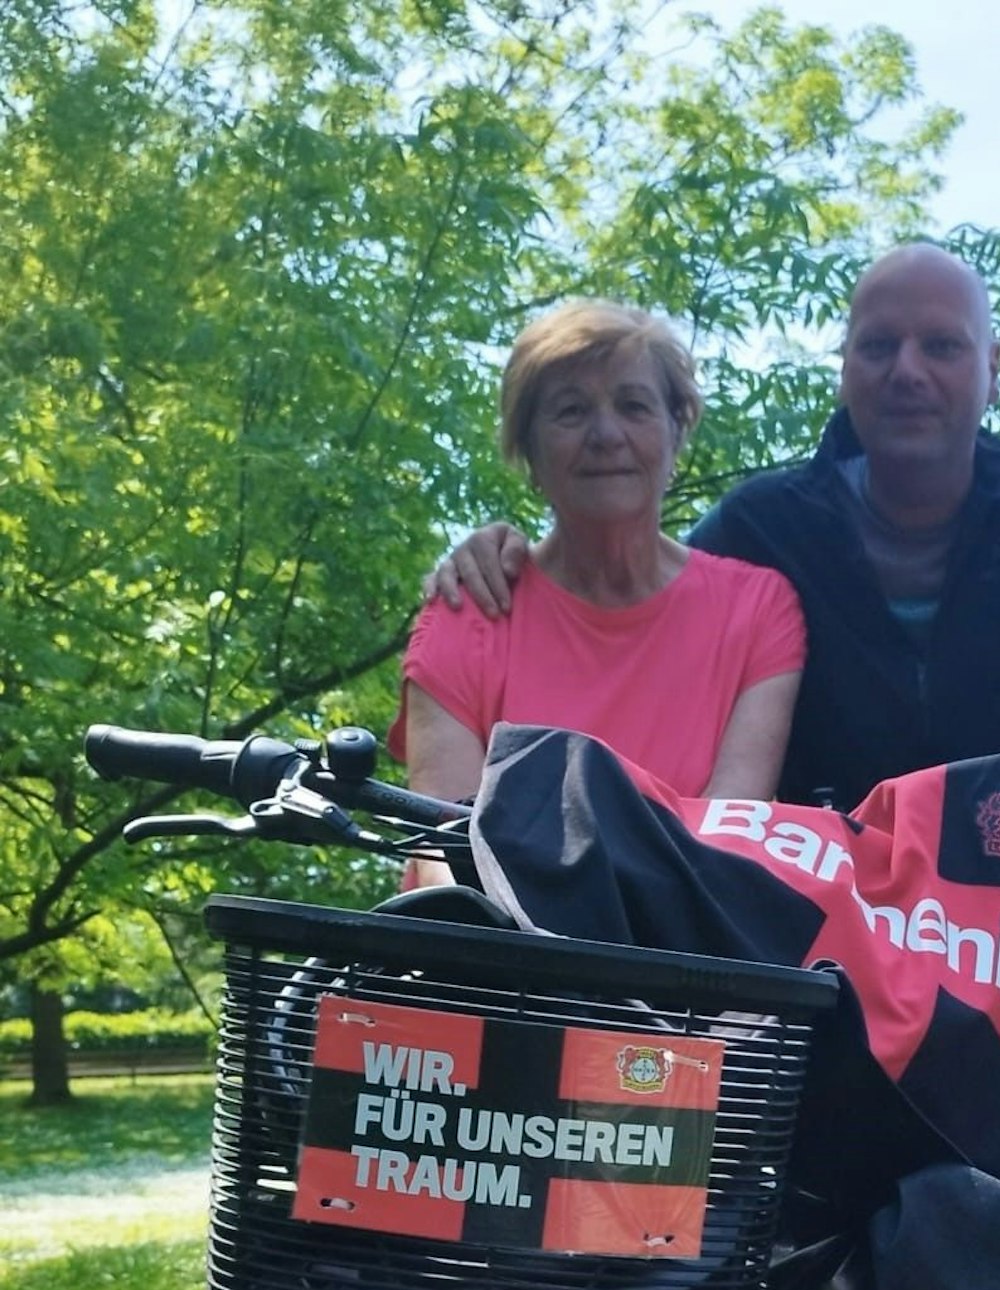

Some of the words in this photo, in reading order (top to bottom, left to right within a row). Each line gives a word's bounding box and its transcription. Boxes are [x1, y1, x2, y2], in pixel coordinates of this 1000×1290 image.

[362, 1040, 467, 1097] WIR.
[355, 1088, 446, 1147] FÜR
[458, 1110, 674, 1167] UNSEREN
[351, 1146, 533, 1209] TRAUM.
